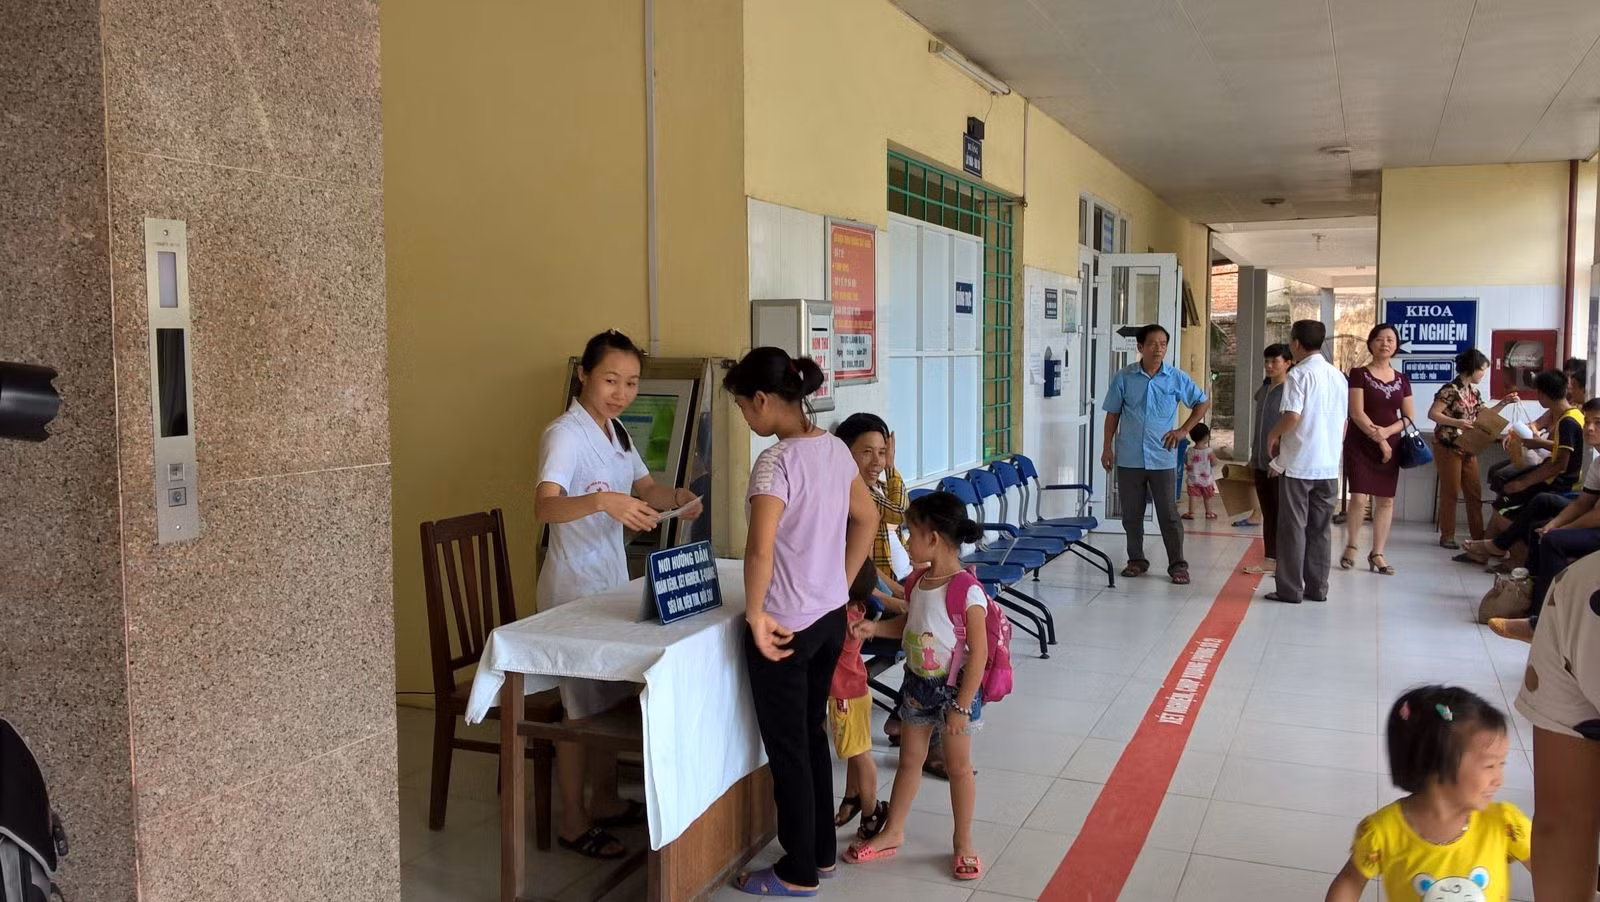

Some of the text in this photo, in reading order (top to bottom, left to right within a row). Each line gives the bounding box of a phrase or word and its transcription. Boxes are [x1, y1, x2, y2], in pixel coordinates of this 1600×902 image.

[1406, 305, 1453, 316] KHOA
[1394, 320, 1468, 344] XÉT NGHIỆM
[658, 545, 709, 574] NƠI HƯỚNG DẪN
